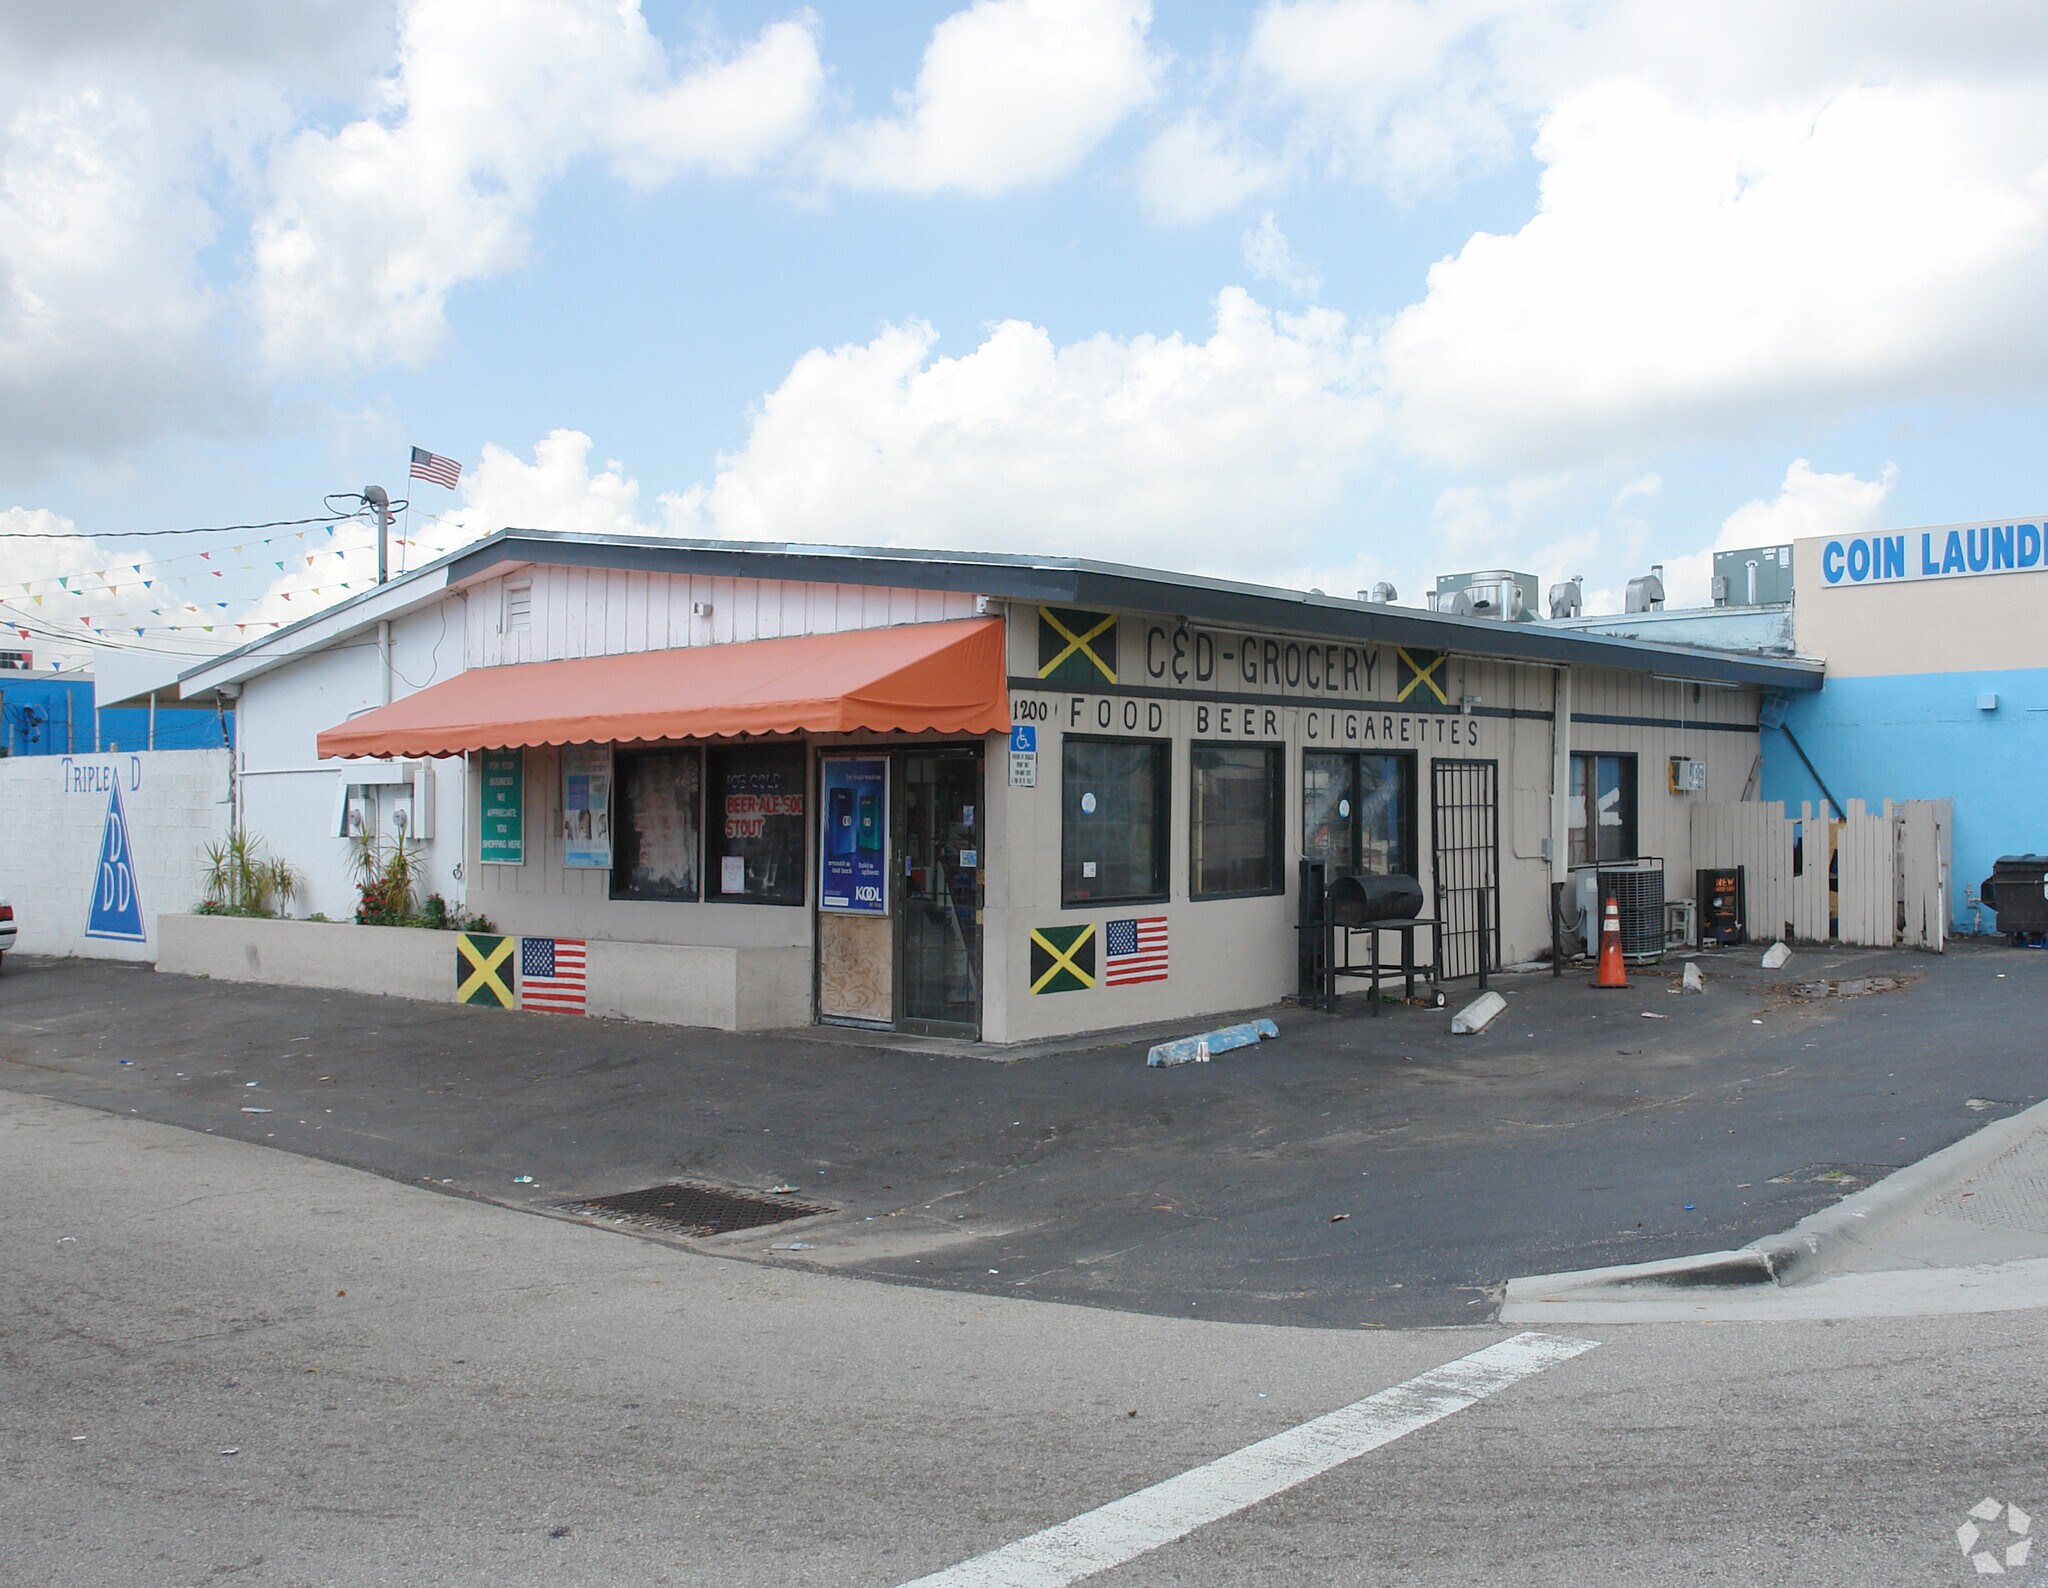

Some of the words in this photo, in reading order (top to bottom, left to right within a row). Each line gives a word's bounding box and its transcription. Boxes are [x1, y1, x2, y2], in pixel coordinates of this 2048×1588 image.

[1823, 535, 1904, 583] COIN
[1922, 522, 2048, 575] LAUND
[1013, 700, 1048, 721] 1200
[1070, 697, 1162, 732] FOOD
[1197, 705, 1277, 735] BEER
[1307, 712, 1478, 746] CIGARETTES
[131, 756, 141, 792] D
[487, 808, 517, 817] APPRECIATE
[110, 812, 121, 862] D
[496, 824, 508, 833] YOU
[726, 818, 764, 837] STOUT
[482, 839, 507, 849] SHOPPING
[855, 886, 882, 902] KOOL
